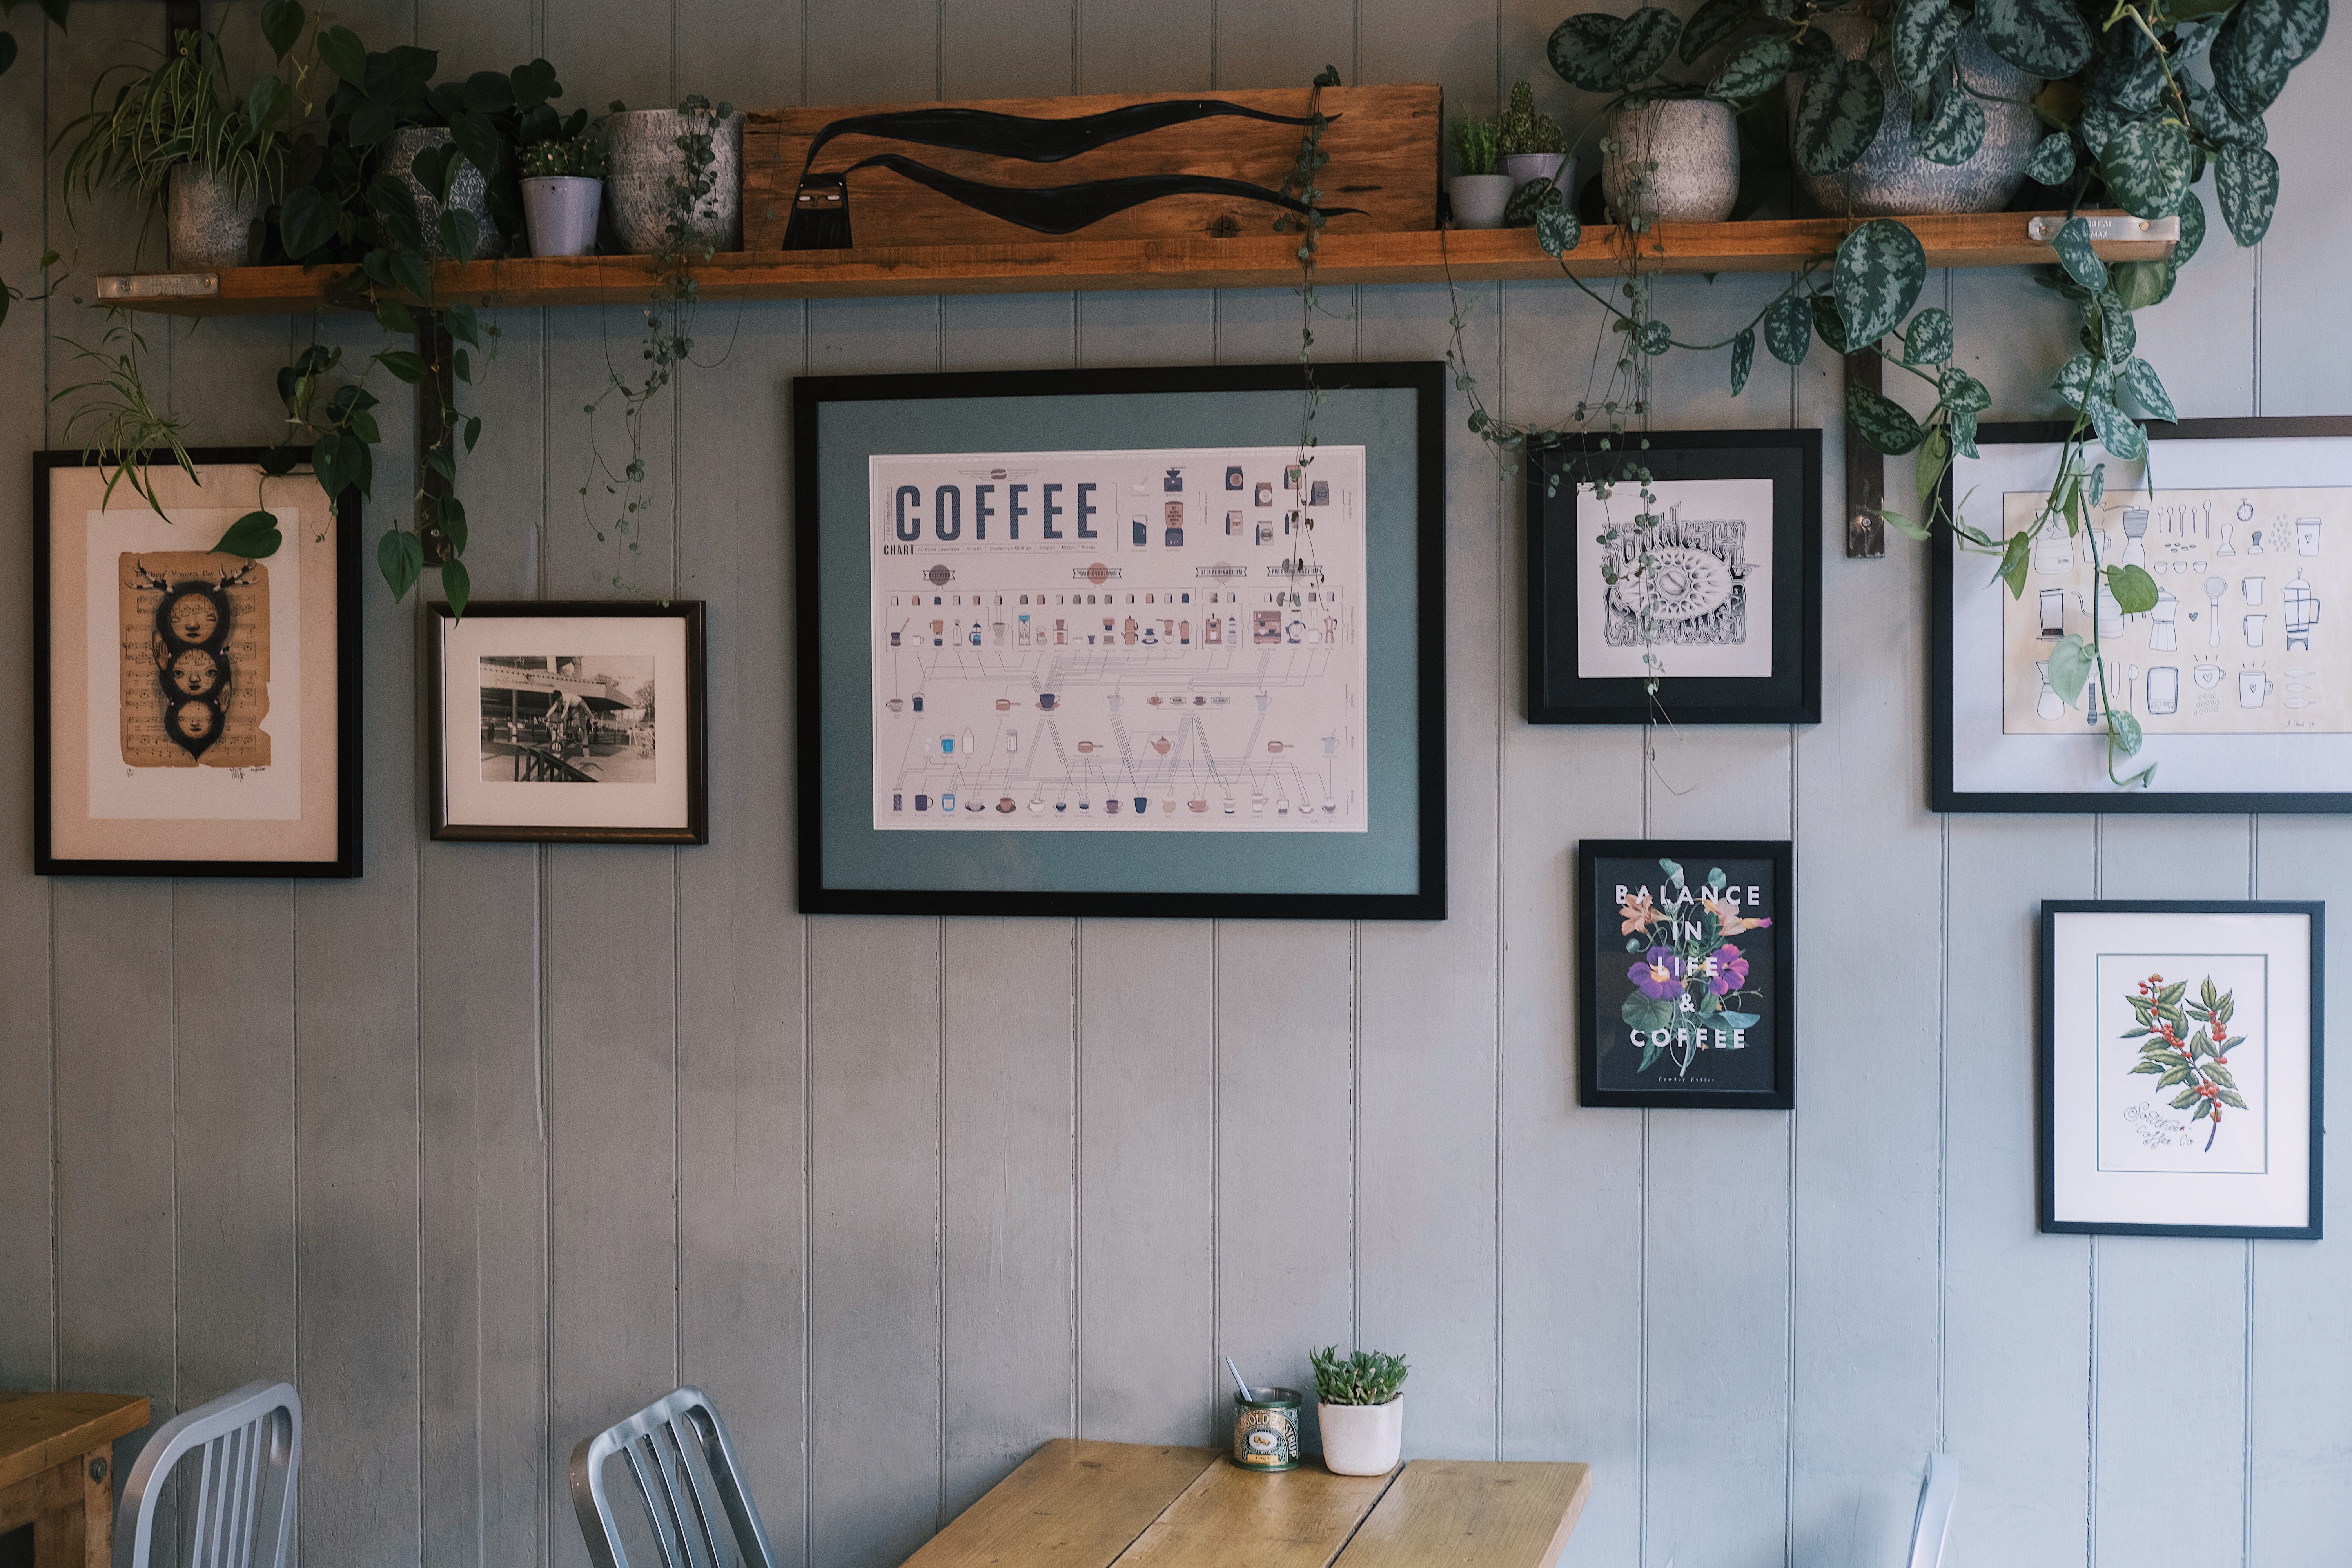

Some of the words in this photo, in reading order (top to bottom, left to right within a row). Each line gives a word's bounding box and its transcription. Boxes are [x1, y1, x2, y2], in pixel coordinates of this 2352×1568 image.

[896, 483, 1097, 541] COFFEE
[884, 544, 915, 555] CHART
[1615, 884, 1760, 906] BALANCE
[1672, 920, 1702, 941] IN
[1657, 956, 1718, 977] LIFE
[1679, 993, 1696, 1013] &
[1630, 1028, 1746, 1049] COFFEE
[1243, 1413, 1284, 1428] GOLDEN
[1285, 1423, 1297, 1458] SYRUP
